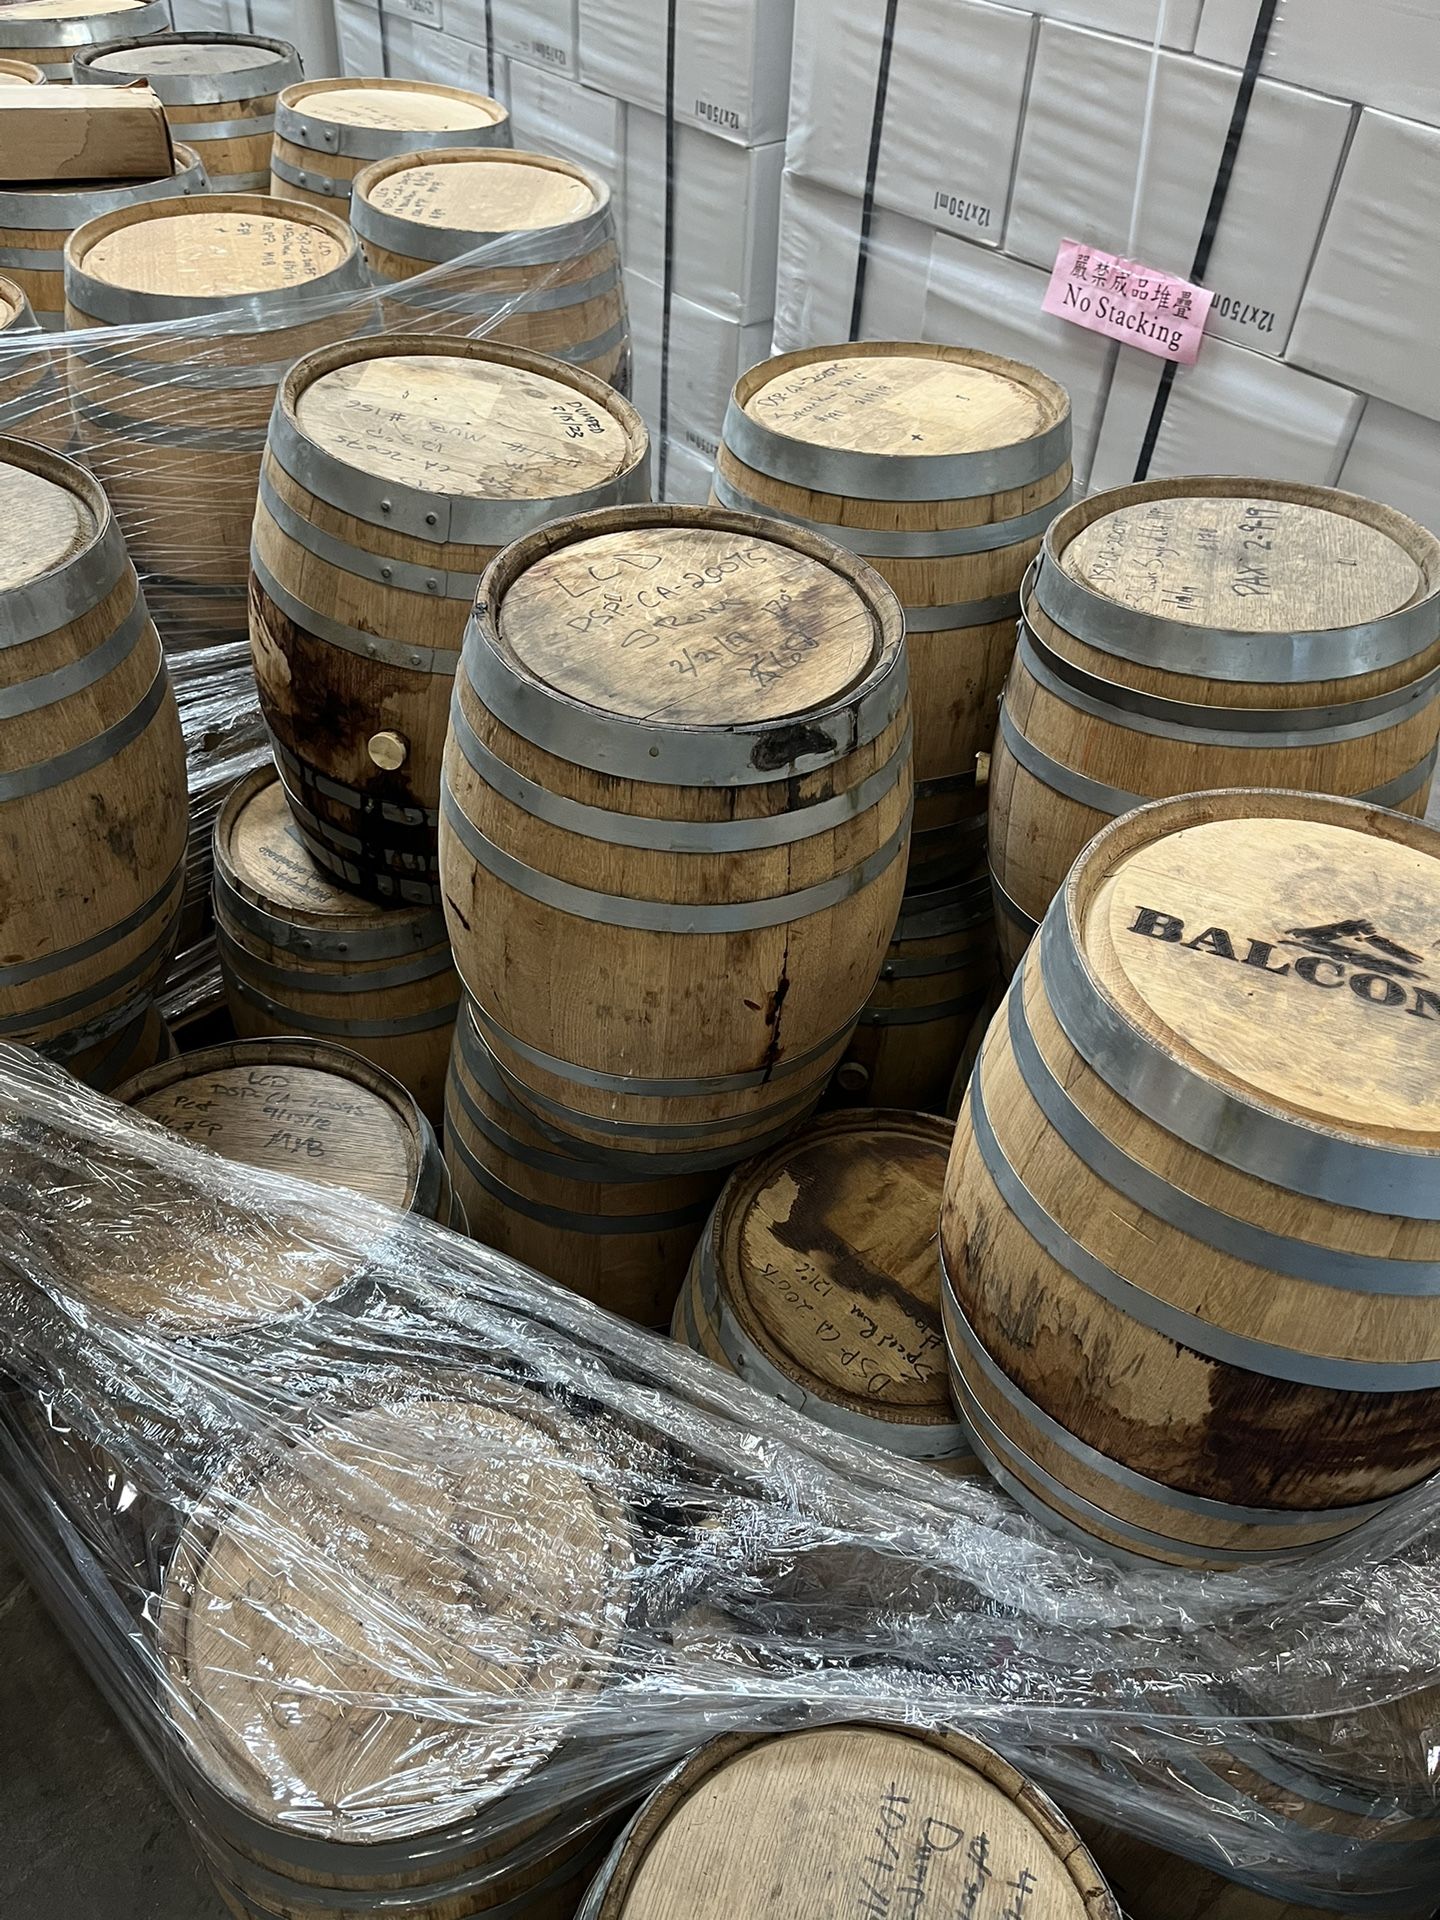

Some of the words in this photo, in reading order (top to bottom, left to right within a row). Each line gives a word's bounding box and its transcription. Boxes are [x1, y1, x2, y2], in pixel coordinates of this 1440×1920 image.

[695, 99, 740, 130] 12x750ml
[933, 191, 991, 227] 12x750ml
[1071, 254, 1193, 320] 嚴禁成品堆疊
[1062, 283, 1091, 313] No
[1095, 296, 1183, 352] Stacking
[1210, 293, 1276, 333] 12x750m
[344, 400, 407, 422] #156
[553, 553, 663, 598] LCD
[1231, 563, 1270, 598] PAX
[248, 1071, 290, 1088] LCD
[849, 1303, 882, 1338] Rum
[877, 1333, 940, 1383] Spiced
